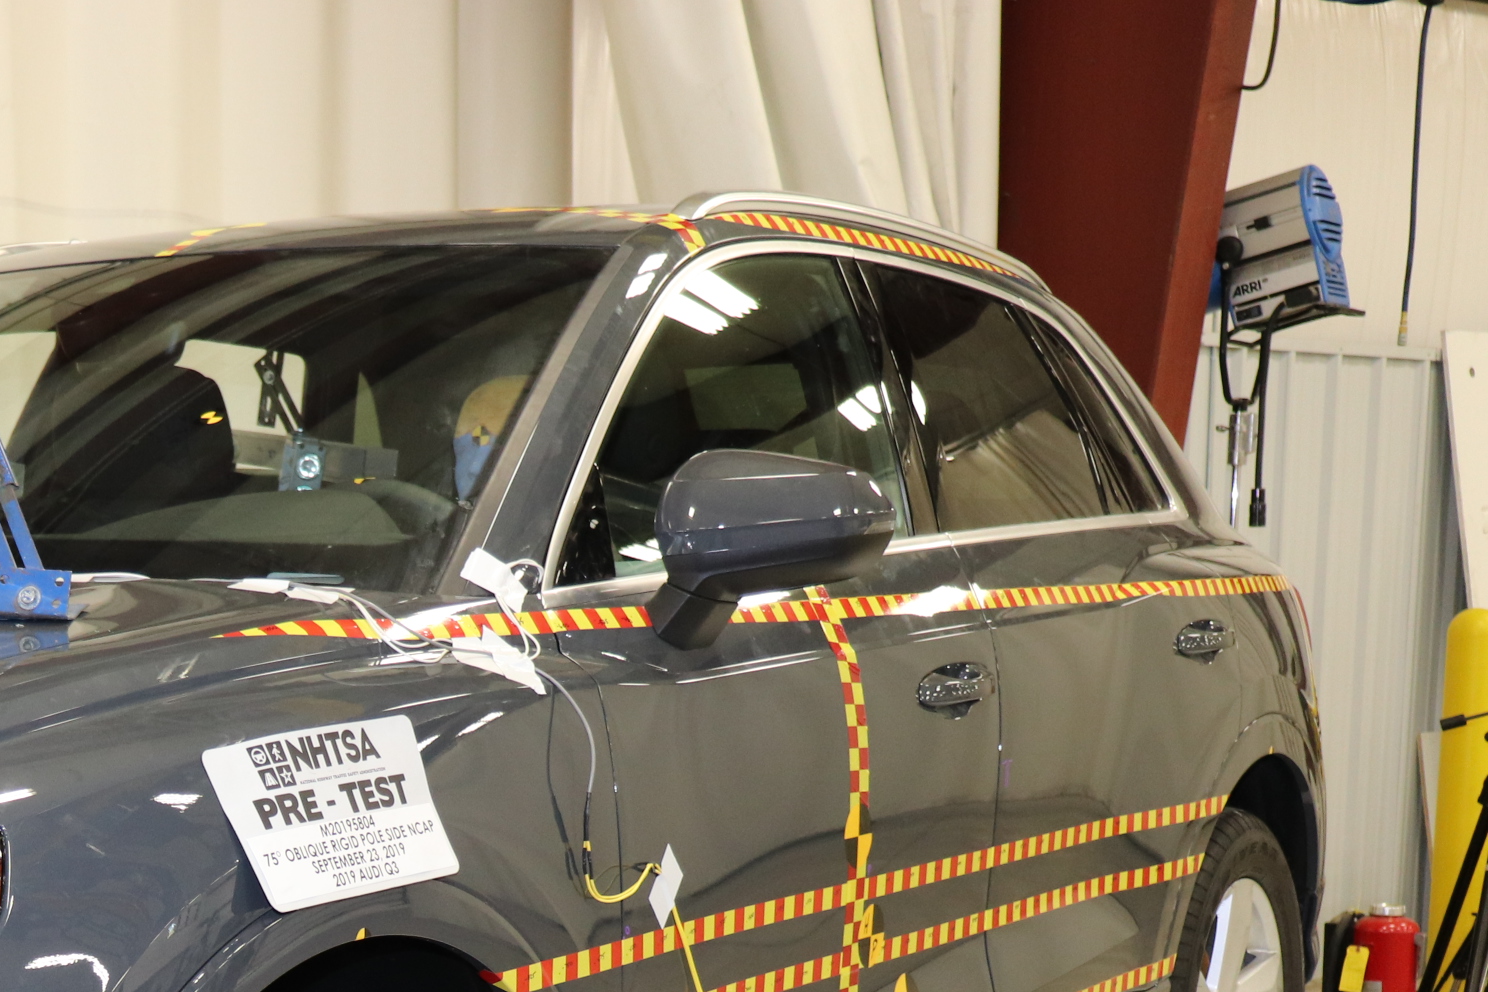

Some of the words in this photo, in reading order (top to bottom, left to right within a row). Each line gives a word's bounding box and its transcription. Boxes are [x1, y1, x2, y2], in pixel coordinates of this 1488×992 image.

[1232, 279, 1262, 298] ARRI
[285, 727, 381, 772] NHTSA
[319, 814, 376, 837] M20195804
[263, 850, 281, 867] 75°
[285, 841, 330, 863] OBLIQUE
[330, 835, 359, 855] RIGID
[361, 829, 385, 847] POLE
[385, 825, 408, 842] SIDE
[407, 819, 434, 836] NCAP
[312, 851, 365, 874] SEPTEMBER
[367, 848, 383, 863] 23,
[385, 842, 406, 859] 2019
[332, 869, 357, 887] 2019
[359, 865, 384, 882] AUDI
[384, 861, 400, 876] Q3
